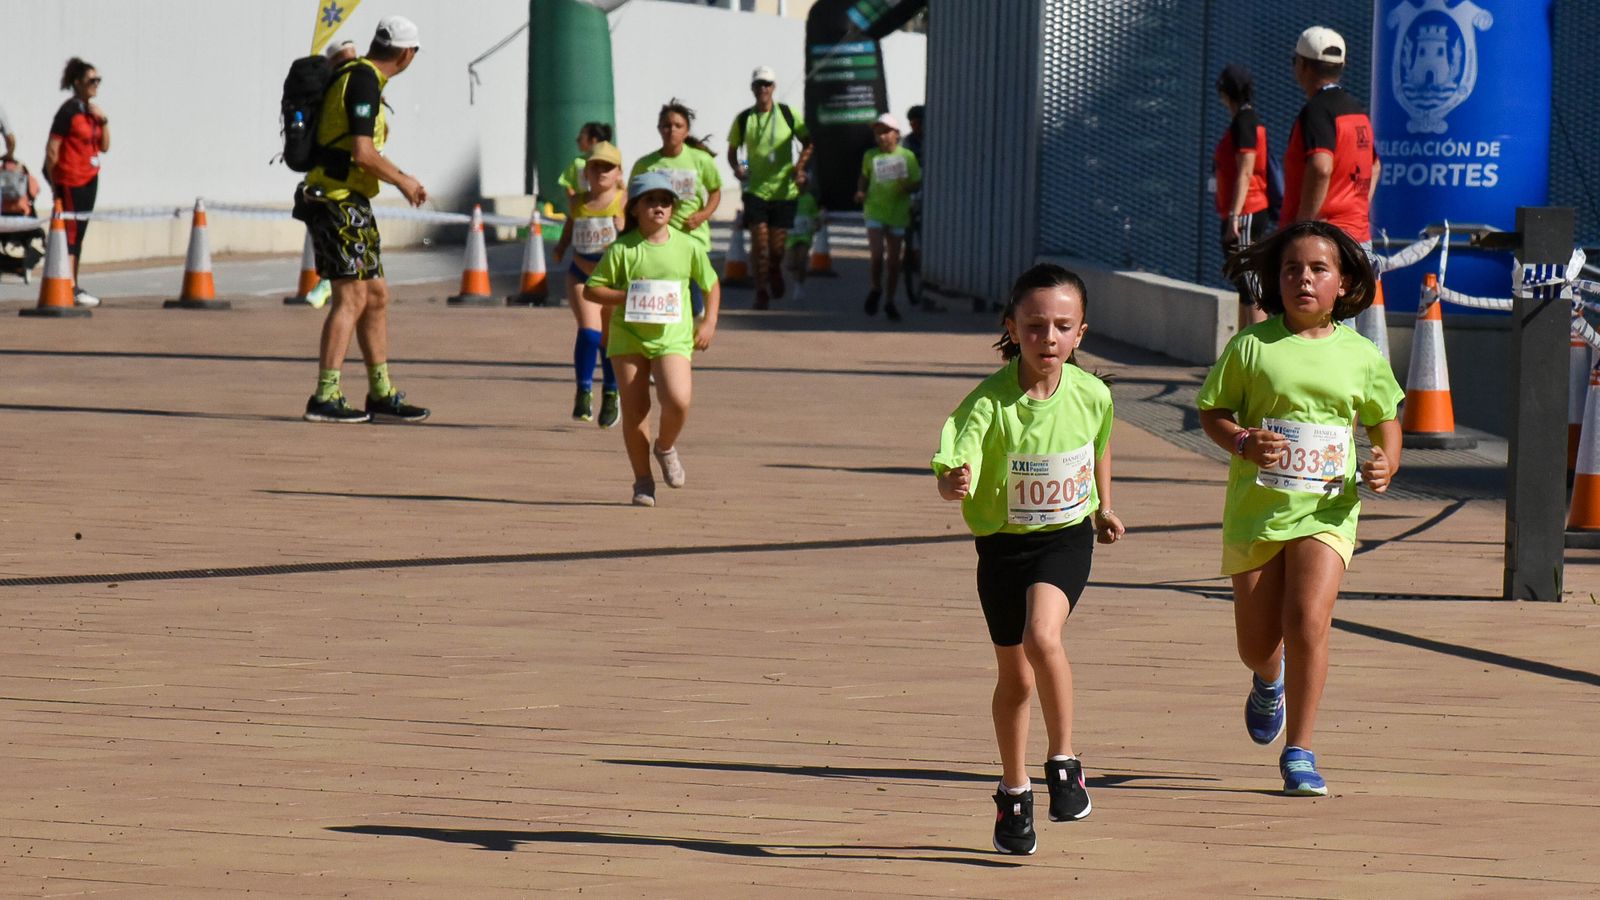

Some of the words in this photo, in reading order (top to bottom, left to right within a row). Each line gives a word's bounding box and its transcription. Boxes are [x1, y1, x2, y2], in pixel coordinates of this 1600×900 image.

[1475, 141, 1500, 157] DE
[1380, 163, 1499, 188] EPORTES
[631, 295, 664, 311] 1448
[1011, 460, 1030, 472] XXI
[1279, 446, 1321, 473] 033
[1015, 477, 1075, 506] 1020
